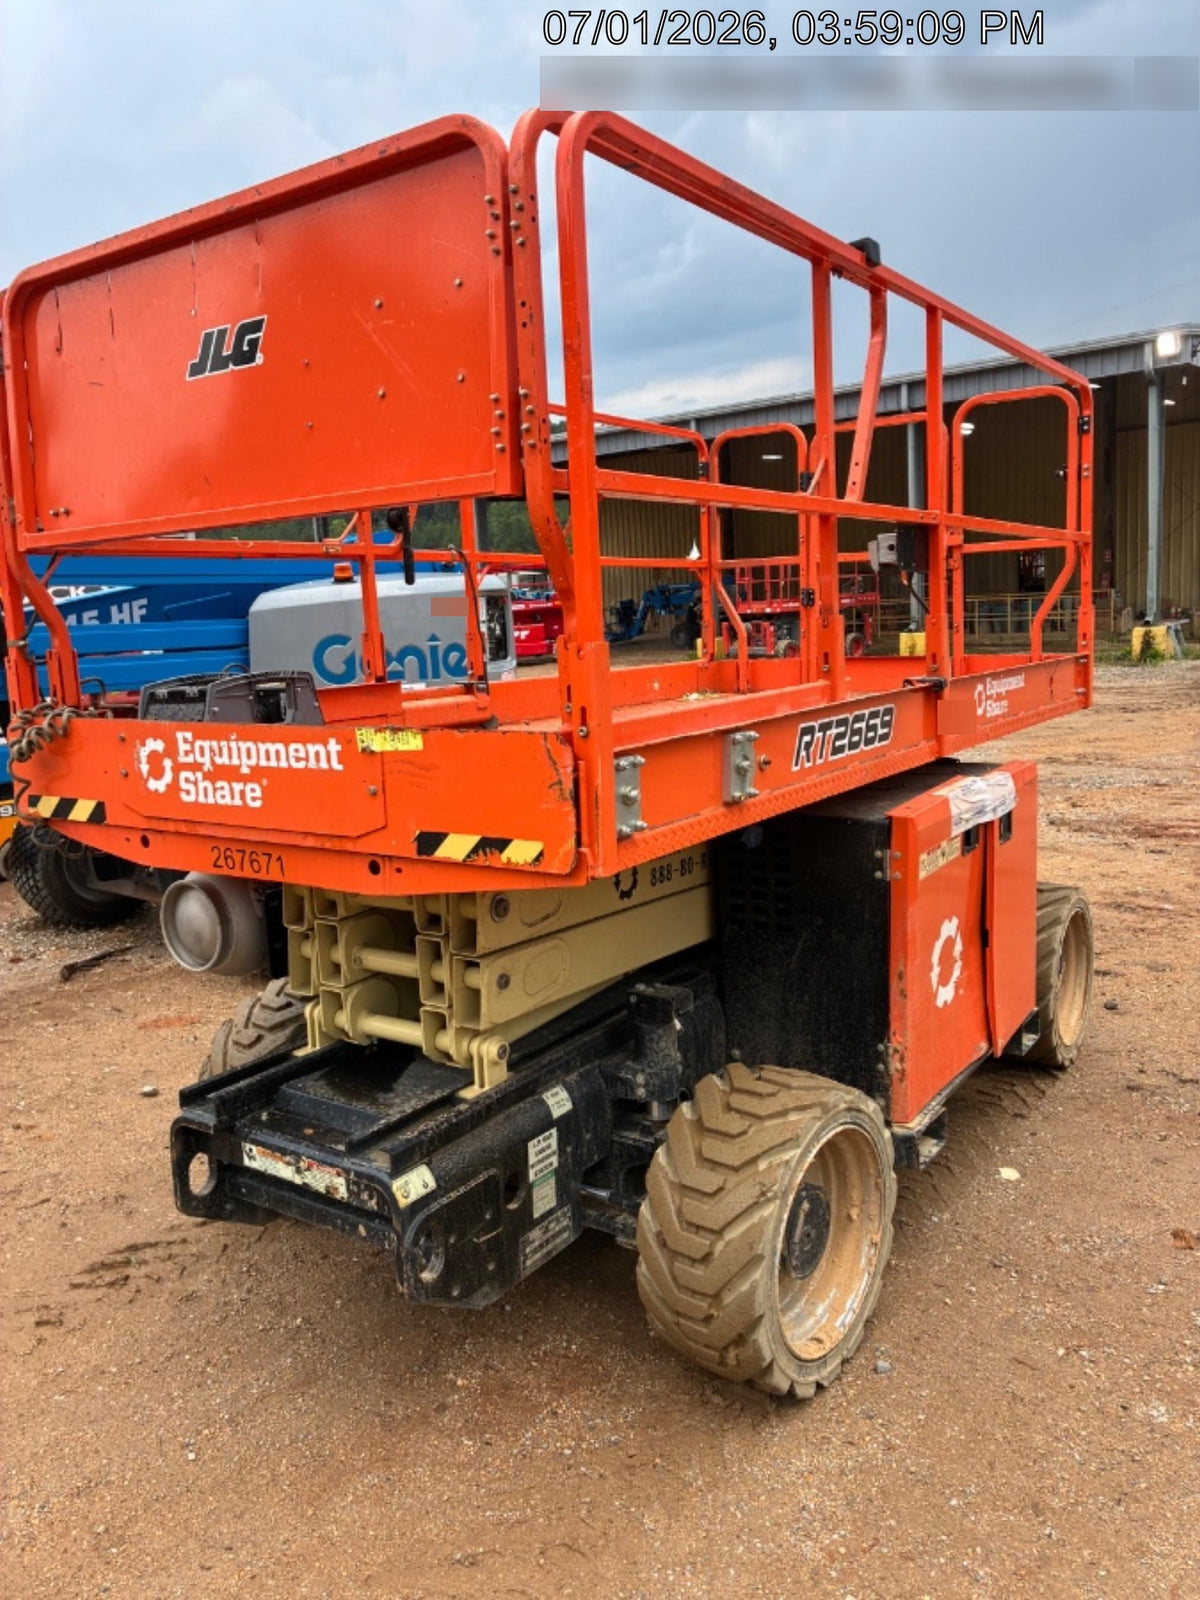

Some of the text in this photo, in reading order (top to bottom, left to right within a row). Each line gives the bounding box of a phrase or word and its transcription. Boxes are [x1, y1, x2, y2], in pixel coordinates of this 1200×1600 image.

[186, 315, 267, 381] JLG
[986, 672, 1025, 699] Equipment
[986, 699, 1009, 718] Share
[175, 731, 344, 773] Equipment
[791, 704, 895, 771] RT2669
[179, 771, 263, 808] Share
[210, 846, 286, 878] 267671
